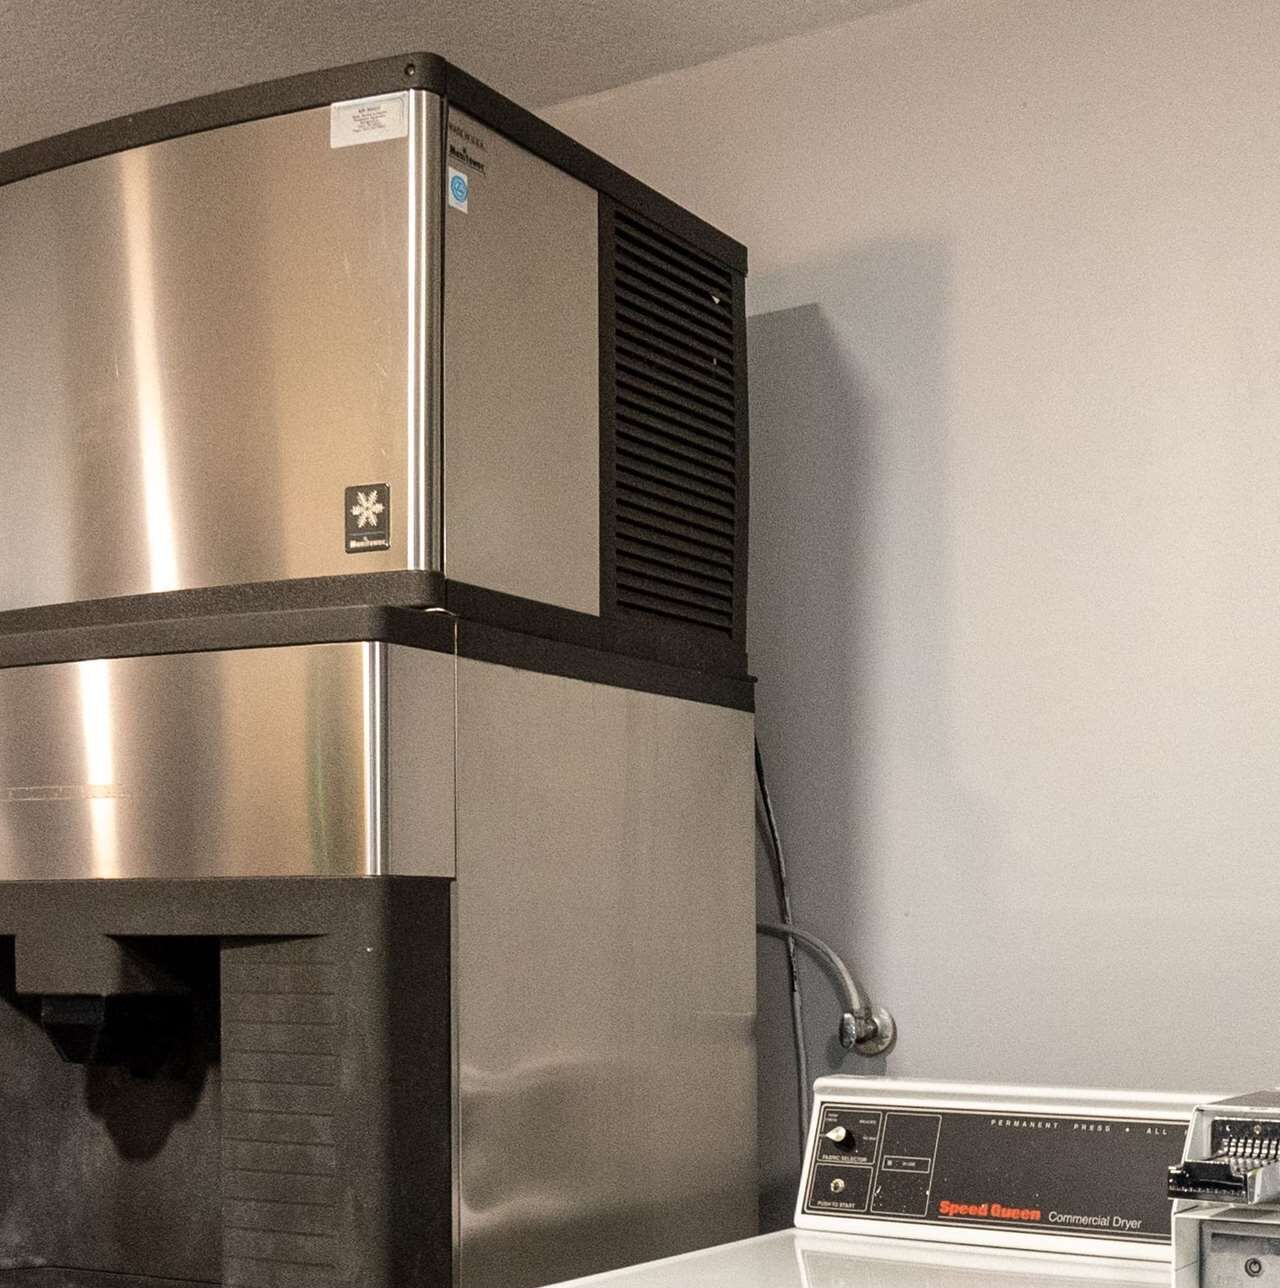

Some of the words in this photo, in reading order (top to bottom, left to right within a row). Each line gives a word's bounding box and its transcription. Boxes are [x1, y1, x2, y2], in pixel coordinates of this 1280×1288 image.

[990, 1119, 1060, 1130] PERMANENT
[1073, 1123, 1112, 1132] PRESS
[1146, 1127, 1168, 1136] ALL
[939, 1200, 989, 1217] Speed
[990, 1204, 1041, 1221] Queen
[1048, 1210, 1110, 1226] Commercial
[1112, 1216, 1142, 1230] Dryer
